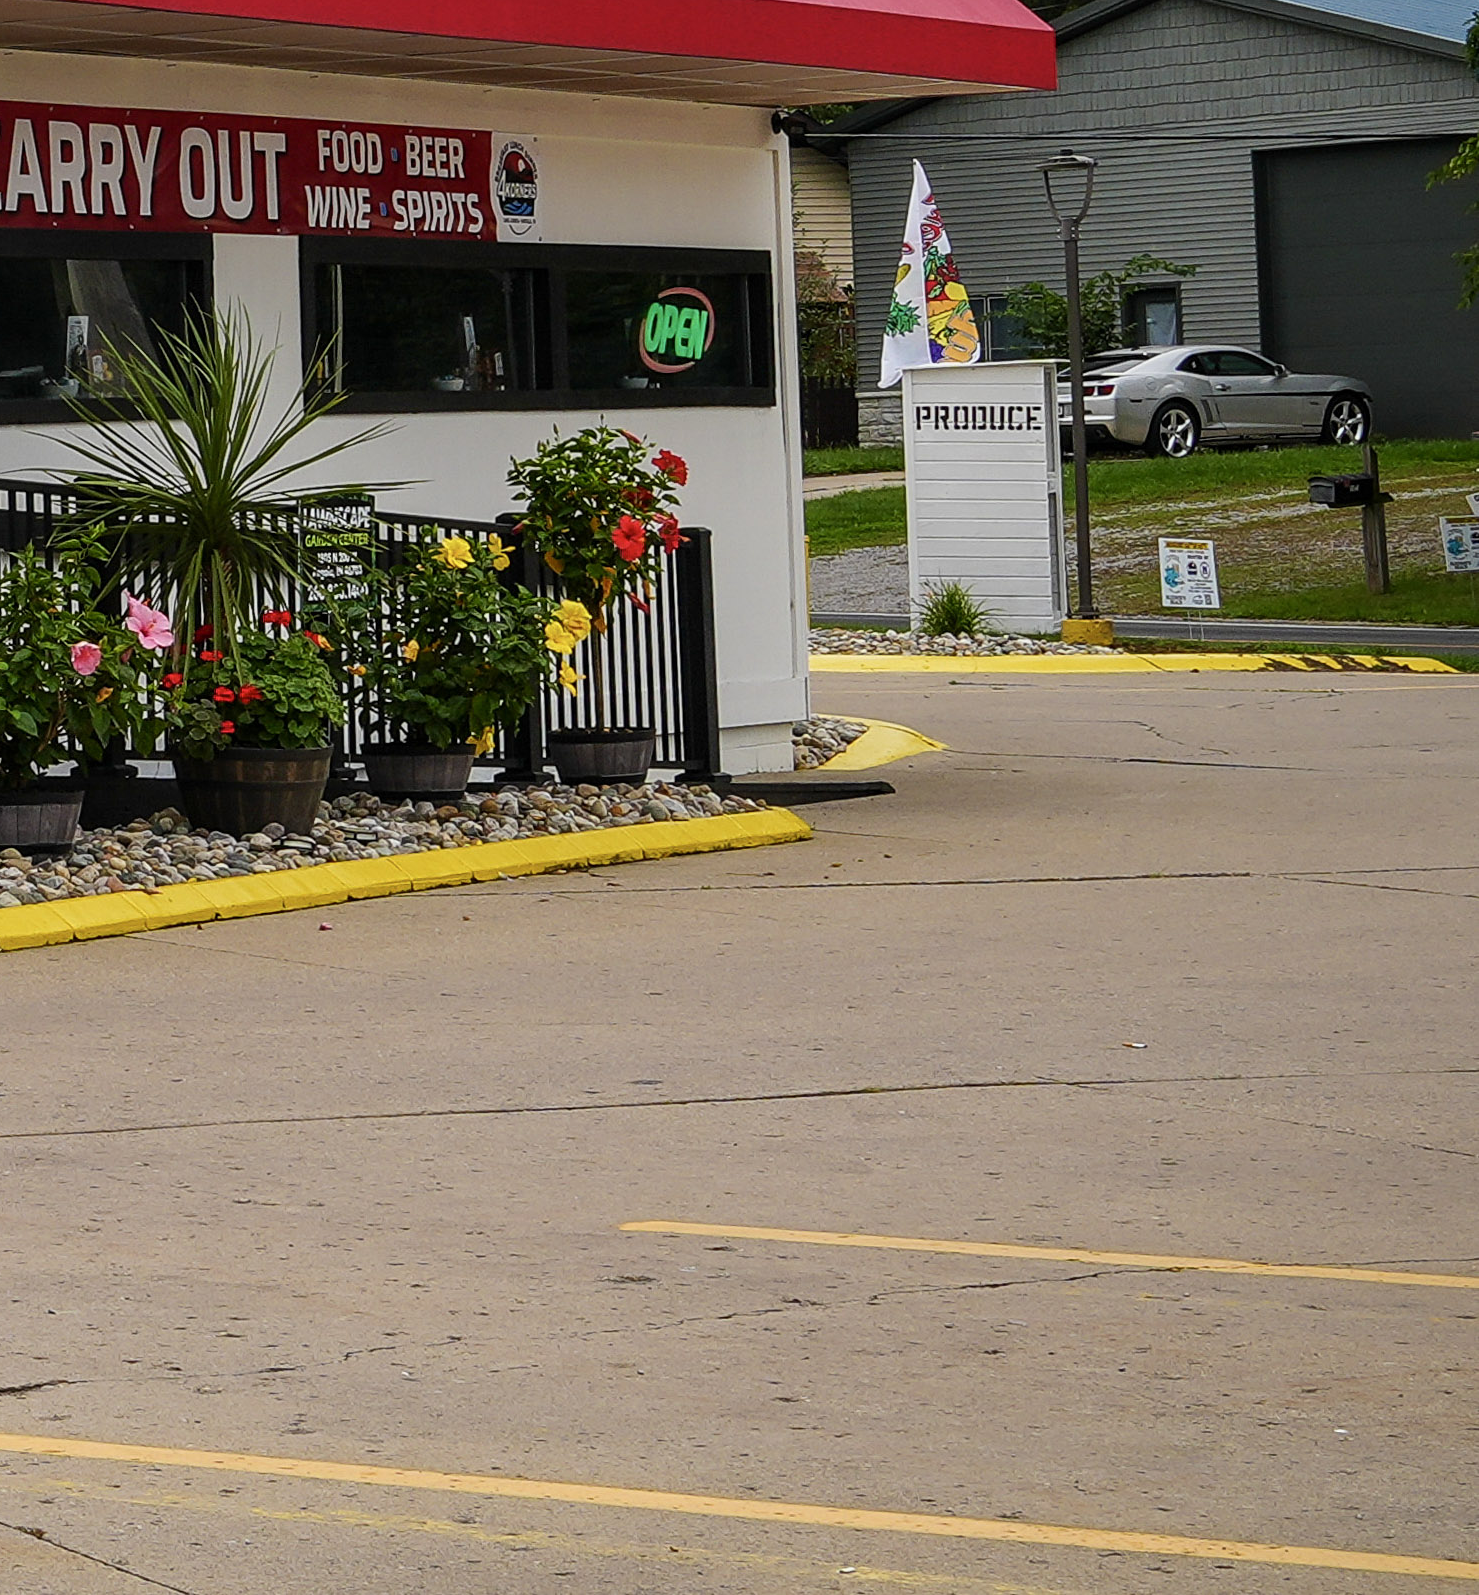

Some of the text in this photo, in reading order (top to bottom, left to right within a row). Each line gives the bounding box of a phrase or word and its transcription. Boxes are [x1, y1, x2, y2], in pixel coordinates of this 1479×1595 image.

[179, 127, 286, 220] OUT
[317, 129, 384, 174] FOOD
[405, 135, 465, 179] BEER
[304, 185, 484, 233] WINE SPIRITS
[644, 302, 708, 360] OPEN
[915, 405, 1042, 430] PRODUCE
